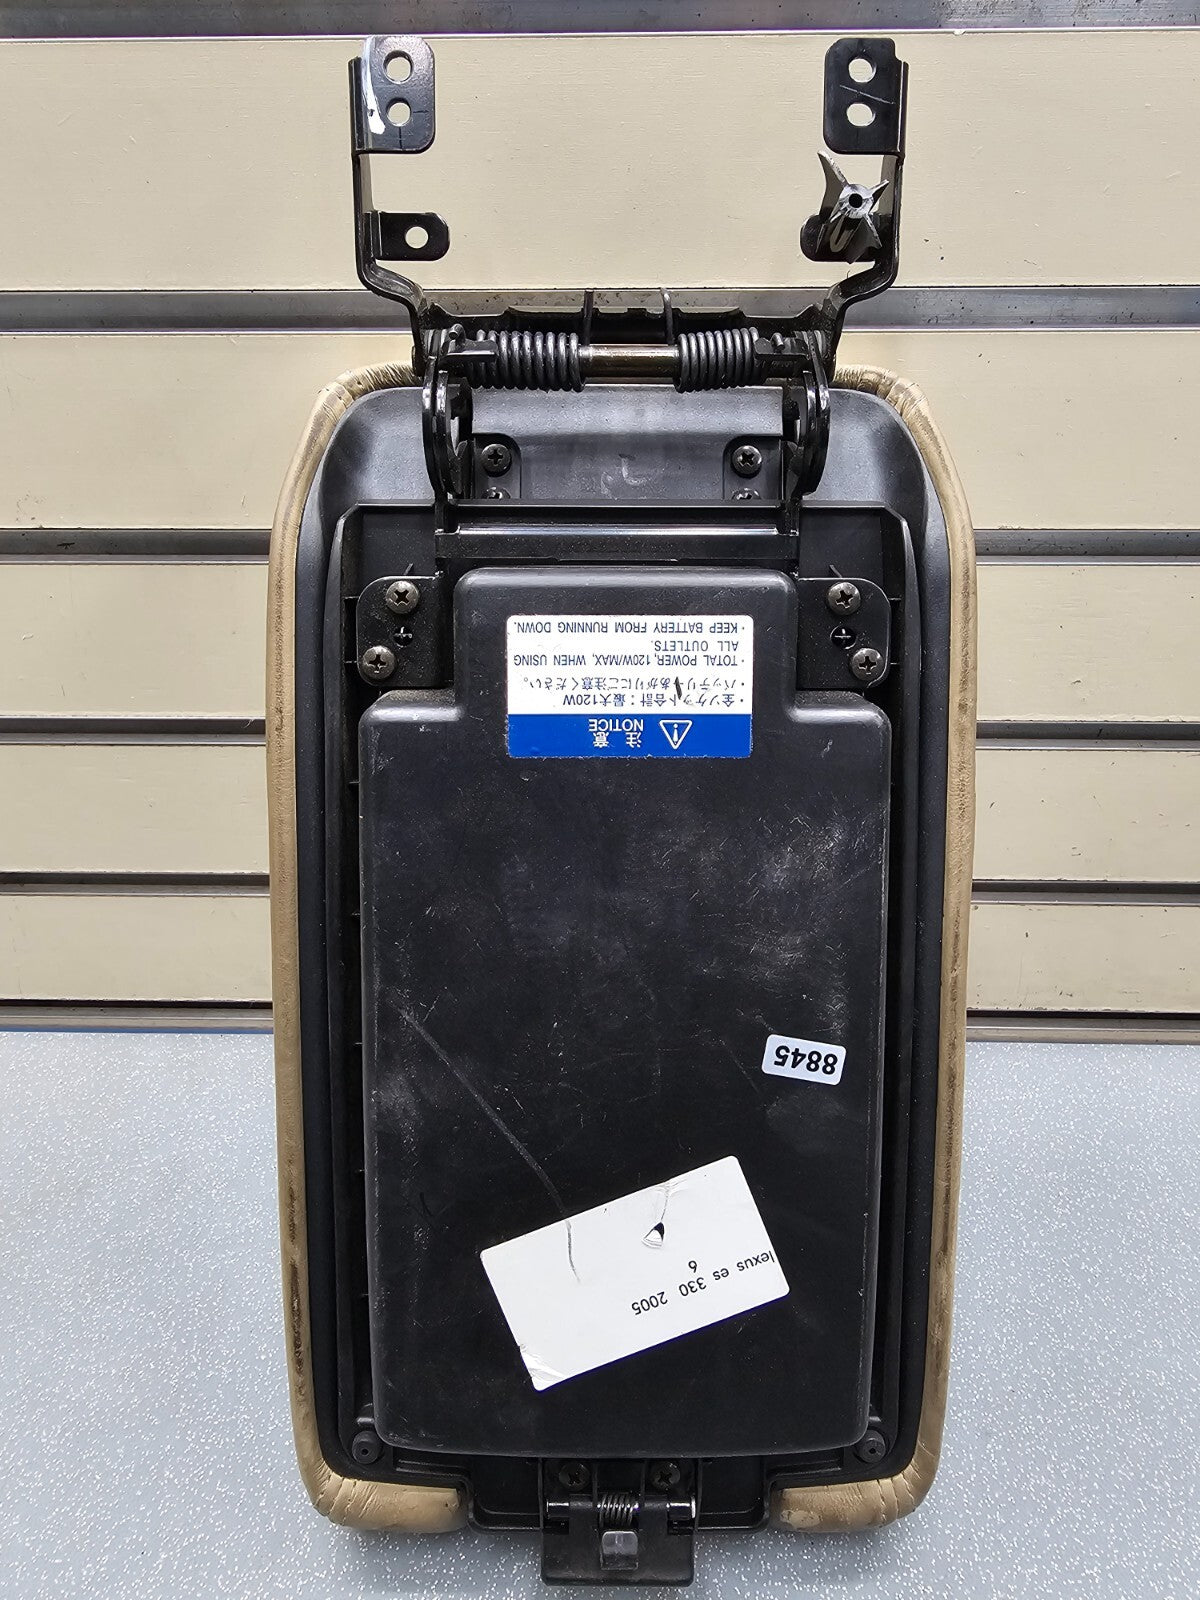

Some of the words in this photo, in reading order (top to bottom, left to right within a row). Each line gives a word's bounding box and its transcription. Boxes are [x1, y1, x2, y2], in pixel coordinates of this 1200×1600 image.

[514, 622, 552, 633] DOWN.
[557, 622, 608, 633] RUNNING
[614, 622, 647, 633] FROM
[653, 622, 703, 633] BATTERY
[709, 622, 738, 633] KEEP
[651, 640, 709, 652] OUTLETS.
[717, 640, 739, 652] ALL
[513, 654, 548, 666] USING
[553, 654, 586, 666] WHEN
[592, 653, 650, 666] 120W/MAX,
[654, 653, 697, 666] POWER,
[703, 654, 738, 666] TOTAL
[588, 719, 644, 731] NOTICE
[774, 1045, 838, 1075] 8845
[687, 1260, 698, 1273] 6
[736, 1250, 776, 1272] lexus
[712, 1267, 730, 1281] es
[678, 1277, 707, 1297] 330
[631, 1291, 668, 1316] 2005
